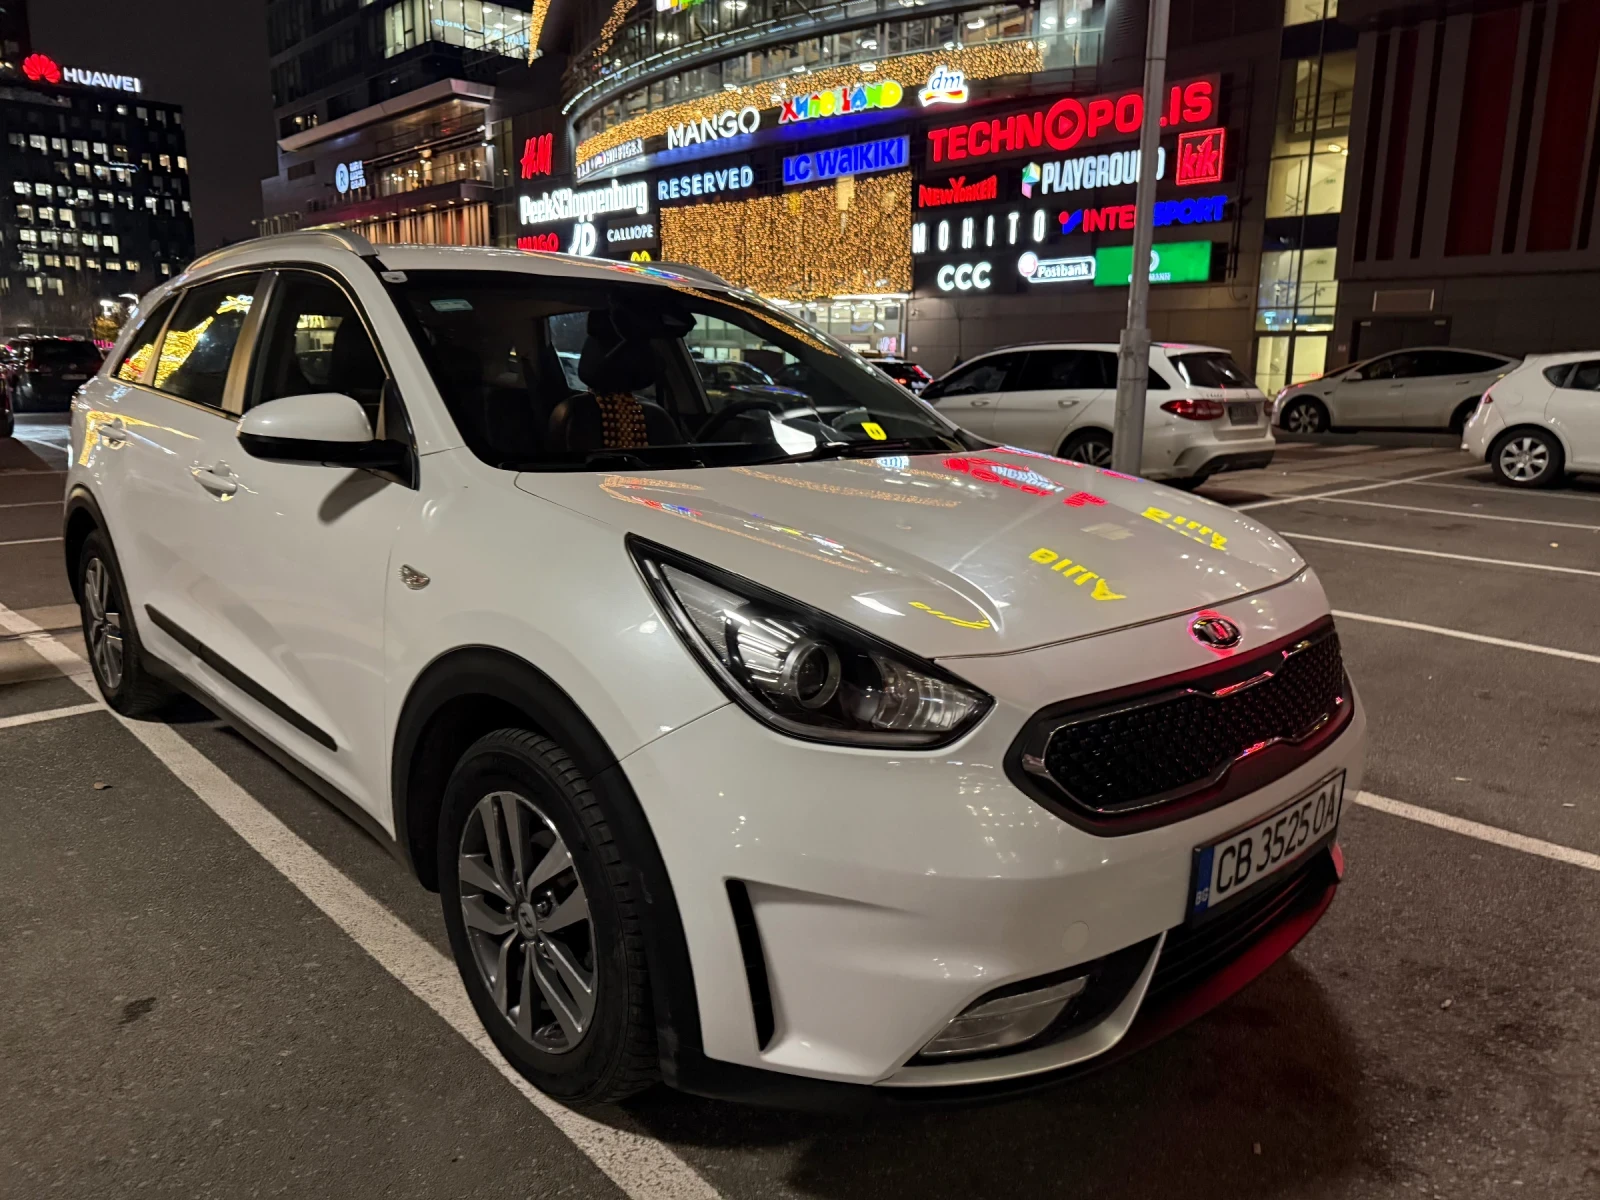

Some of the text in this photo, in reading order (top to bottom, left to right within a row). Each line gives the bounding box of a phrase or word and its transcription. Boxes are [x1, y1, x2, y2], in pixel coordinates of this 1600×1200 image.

[63, 66, 142, 93] HUAWEI
[931, 70, 961, 91] dm
[667, 106, 760, 150] MANGO
[927, 81, 1213, 162] TECHNOPOIS
[658, 165, 754, 201] RESERVED
[784, 155, 811, 182] LC
[912, 209, 1046, 254] MOHITO
[1082, 195, 1229, 233] INTESPORT
[568, 222, 597, 257] JD
[606, 224, 654, 242] CALLIOPE
[937, 261, 992, 291] CCC
[1037, 262, 1089, 278] Postbank
[1216, 837, 1253, 893] CB
[1256, 801, 1312, 873] 3525
